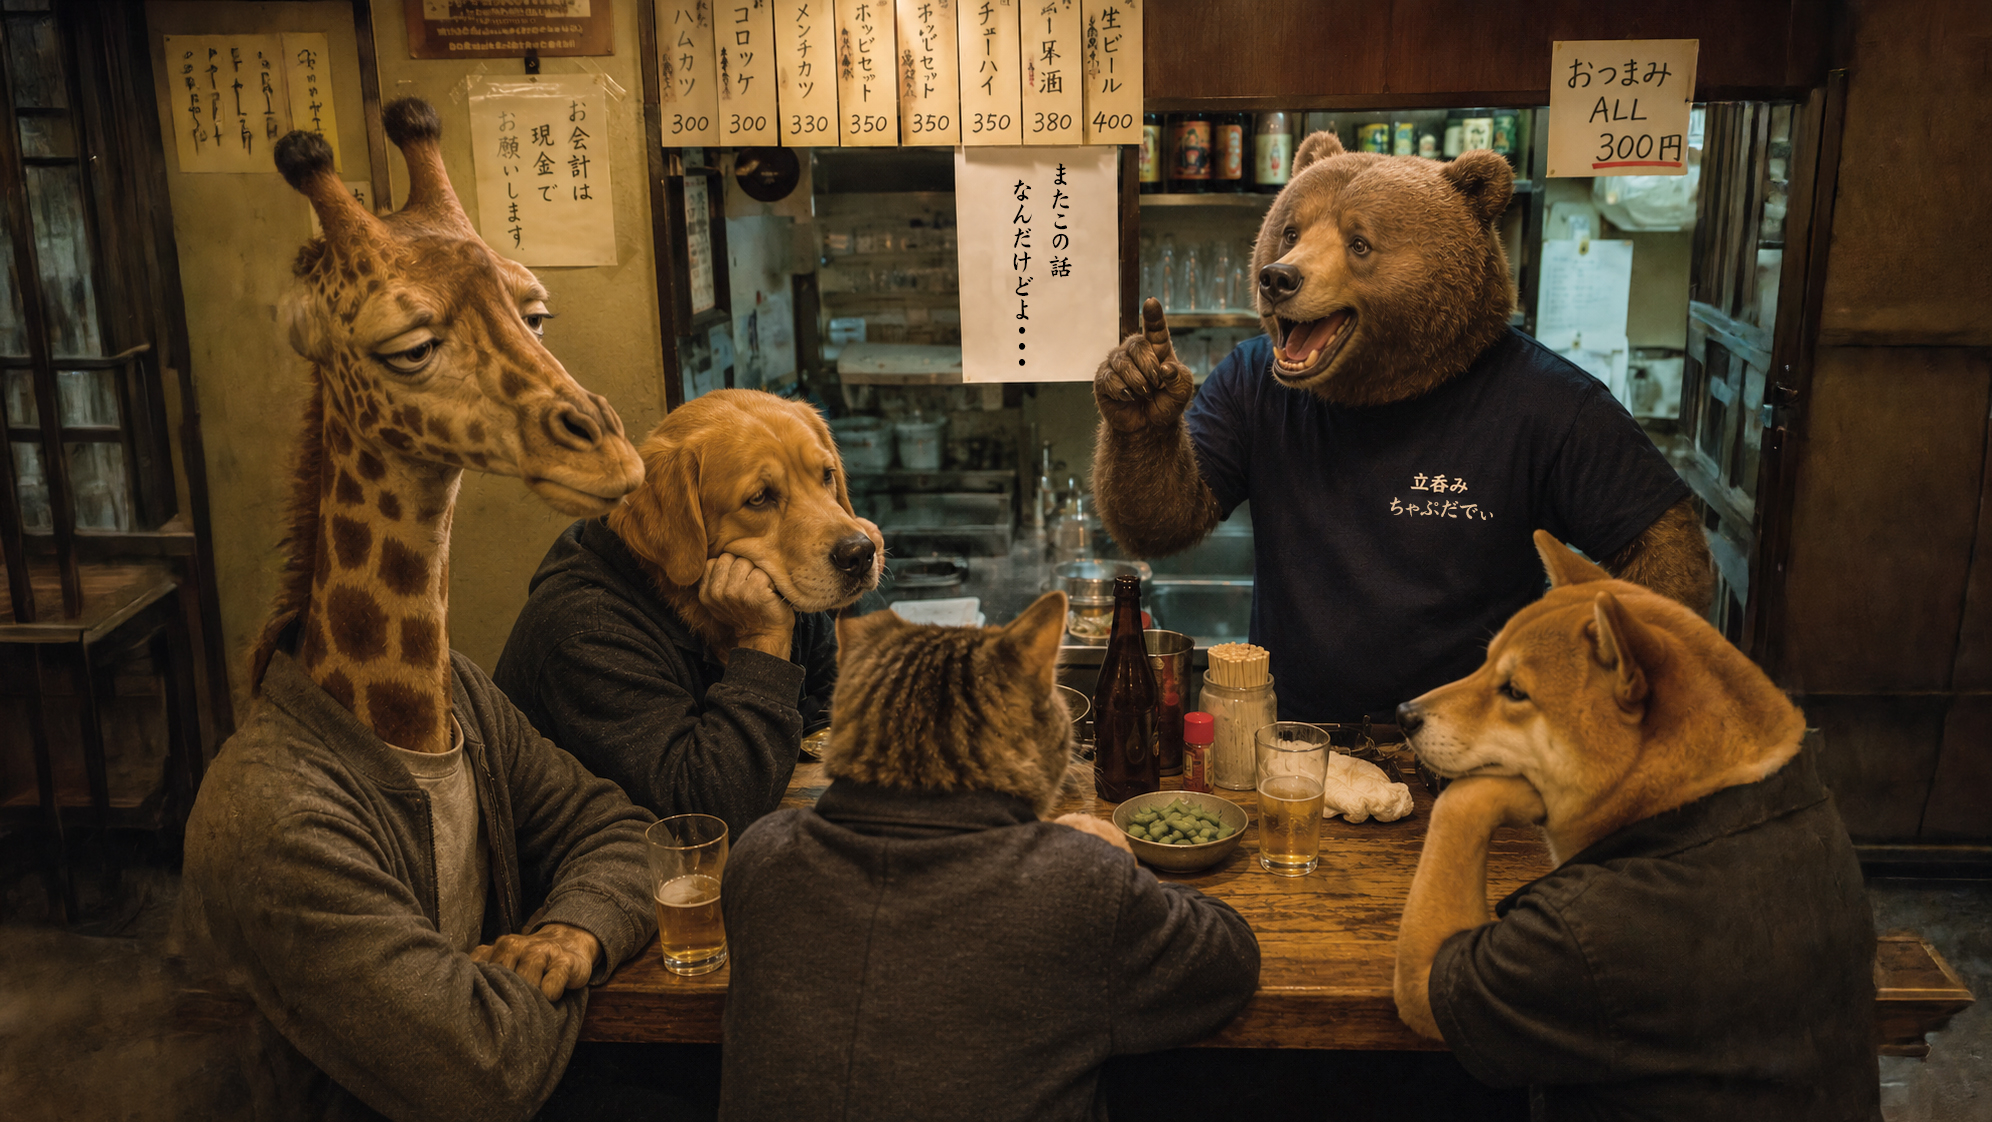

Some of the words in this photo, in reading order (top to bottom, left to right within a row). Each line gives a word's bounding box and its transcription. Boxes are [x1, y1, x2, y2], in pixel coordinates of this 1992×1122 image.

[674, 9, 694, 97] ハムカツ
[734, 7, 754, 95] コロッケ
[796, 4, 814, 99] メンチカツ
[1101, 6, 1123, 94] 生ビール
[1568, 58, 1672, 88] おつまみ
[912, 113, 950, 133] 350
[972, 113, 1011, 133] 350
[1032, 112, 1072, 133] 380
[1093, 111, 1133, 133] 400
[1589, 96, 1647, 123] ALL
[672, 114, 709, 134] 300
[729, 114, 766, 134] 300
[791, 115, 828, 135] 330
[850, 114, 887, 134] 350
[567, 100, 592, 201] お会計は
[1596, 133, 1682, 161] 300円
[531, 124, 557, 202] 現金で
[1049, 163, 1072, 277] またこの話
[1410, 472, 1468, 494] 立呑み
